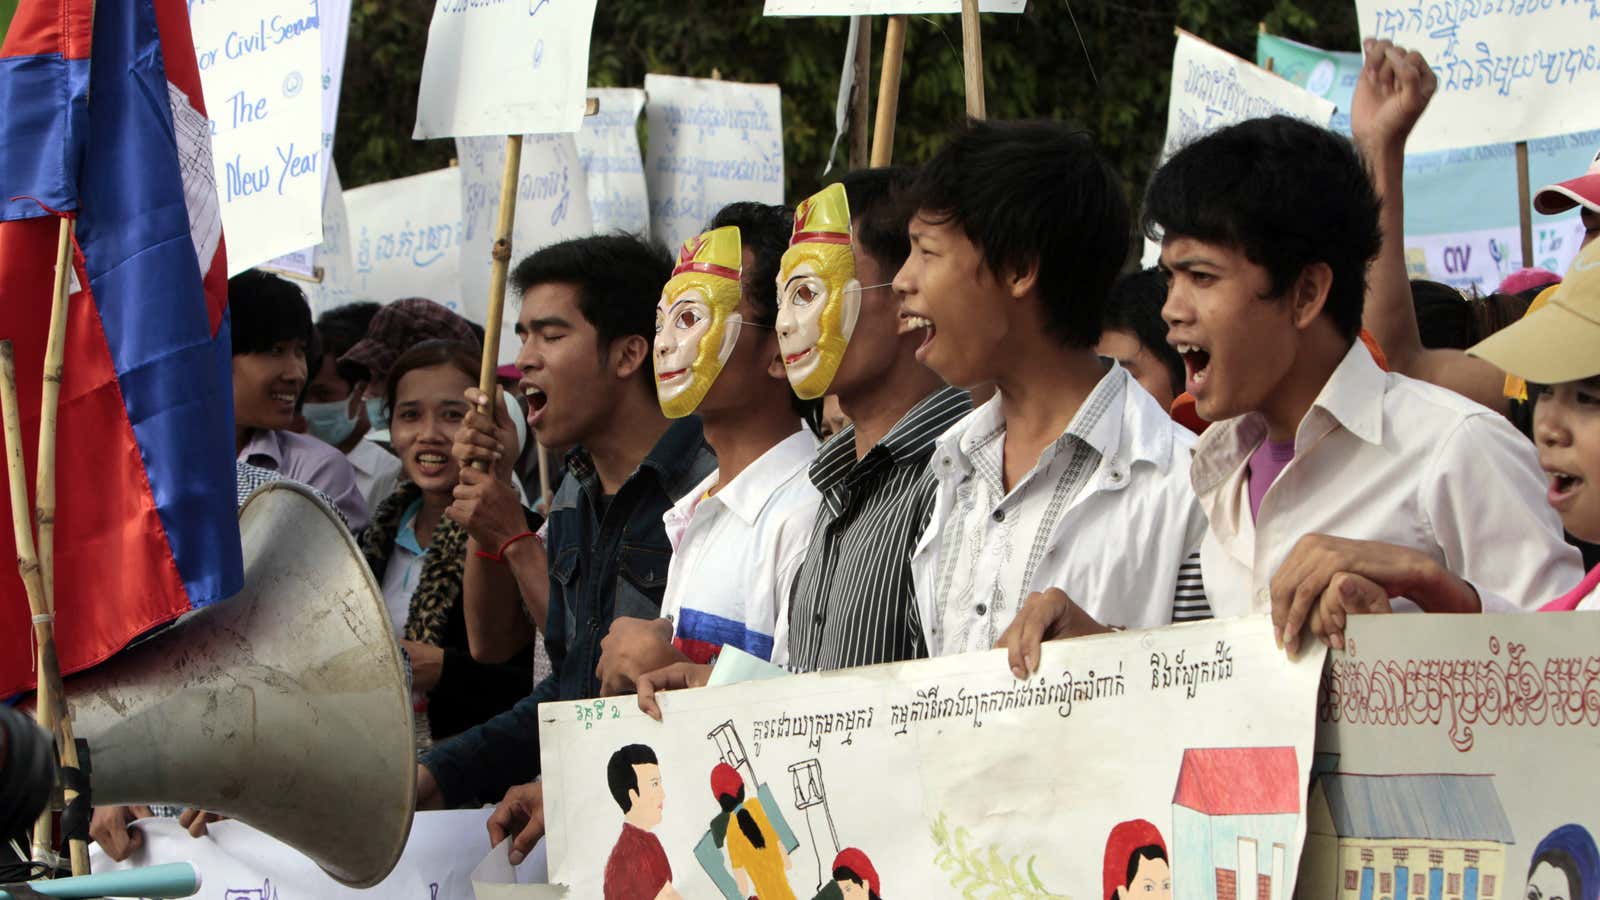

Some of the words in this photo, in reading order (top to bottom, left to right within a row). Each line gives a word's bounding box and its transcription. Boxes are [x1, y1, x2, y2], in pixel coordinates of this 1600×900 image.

[199, 50, 218, 70] or
[225, 90, 268, 128] The
[226, 154, 270, 202] New
[276, 143, 319, 195] Year
